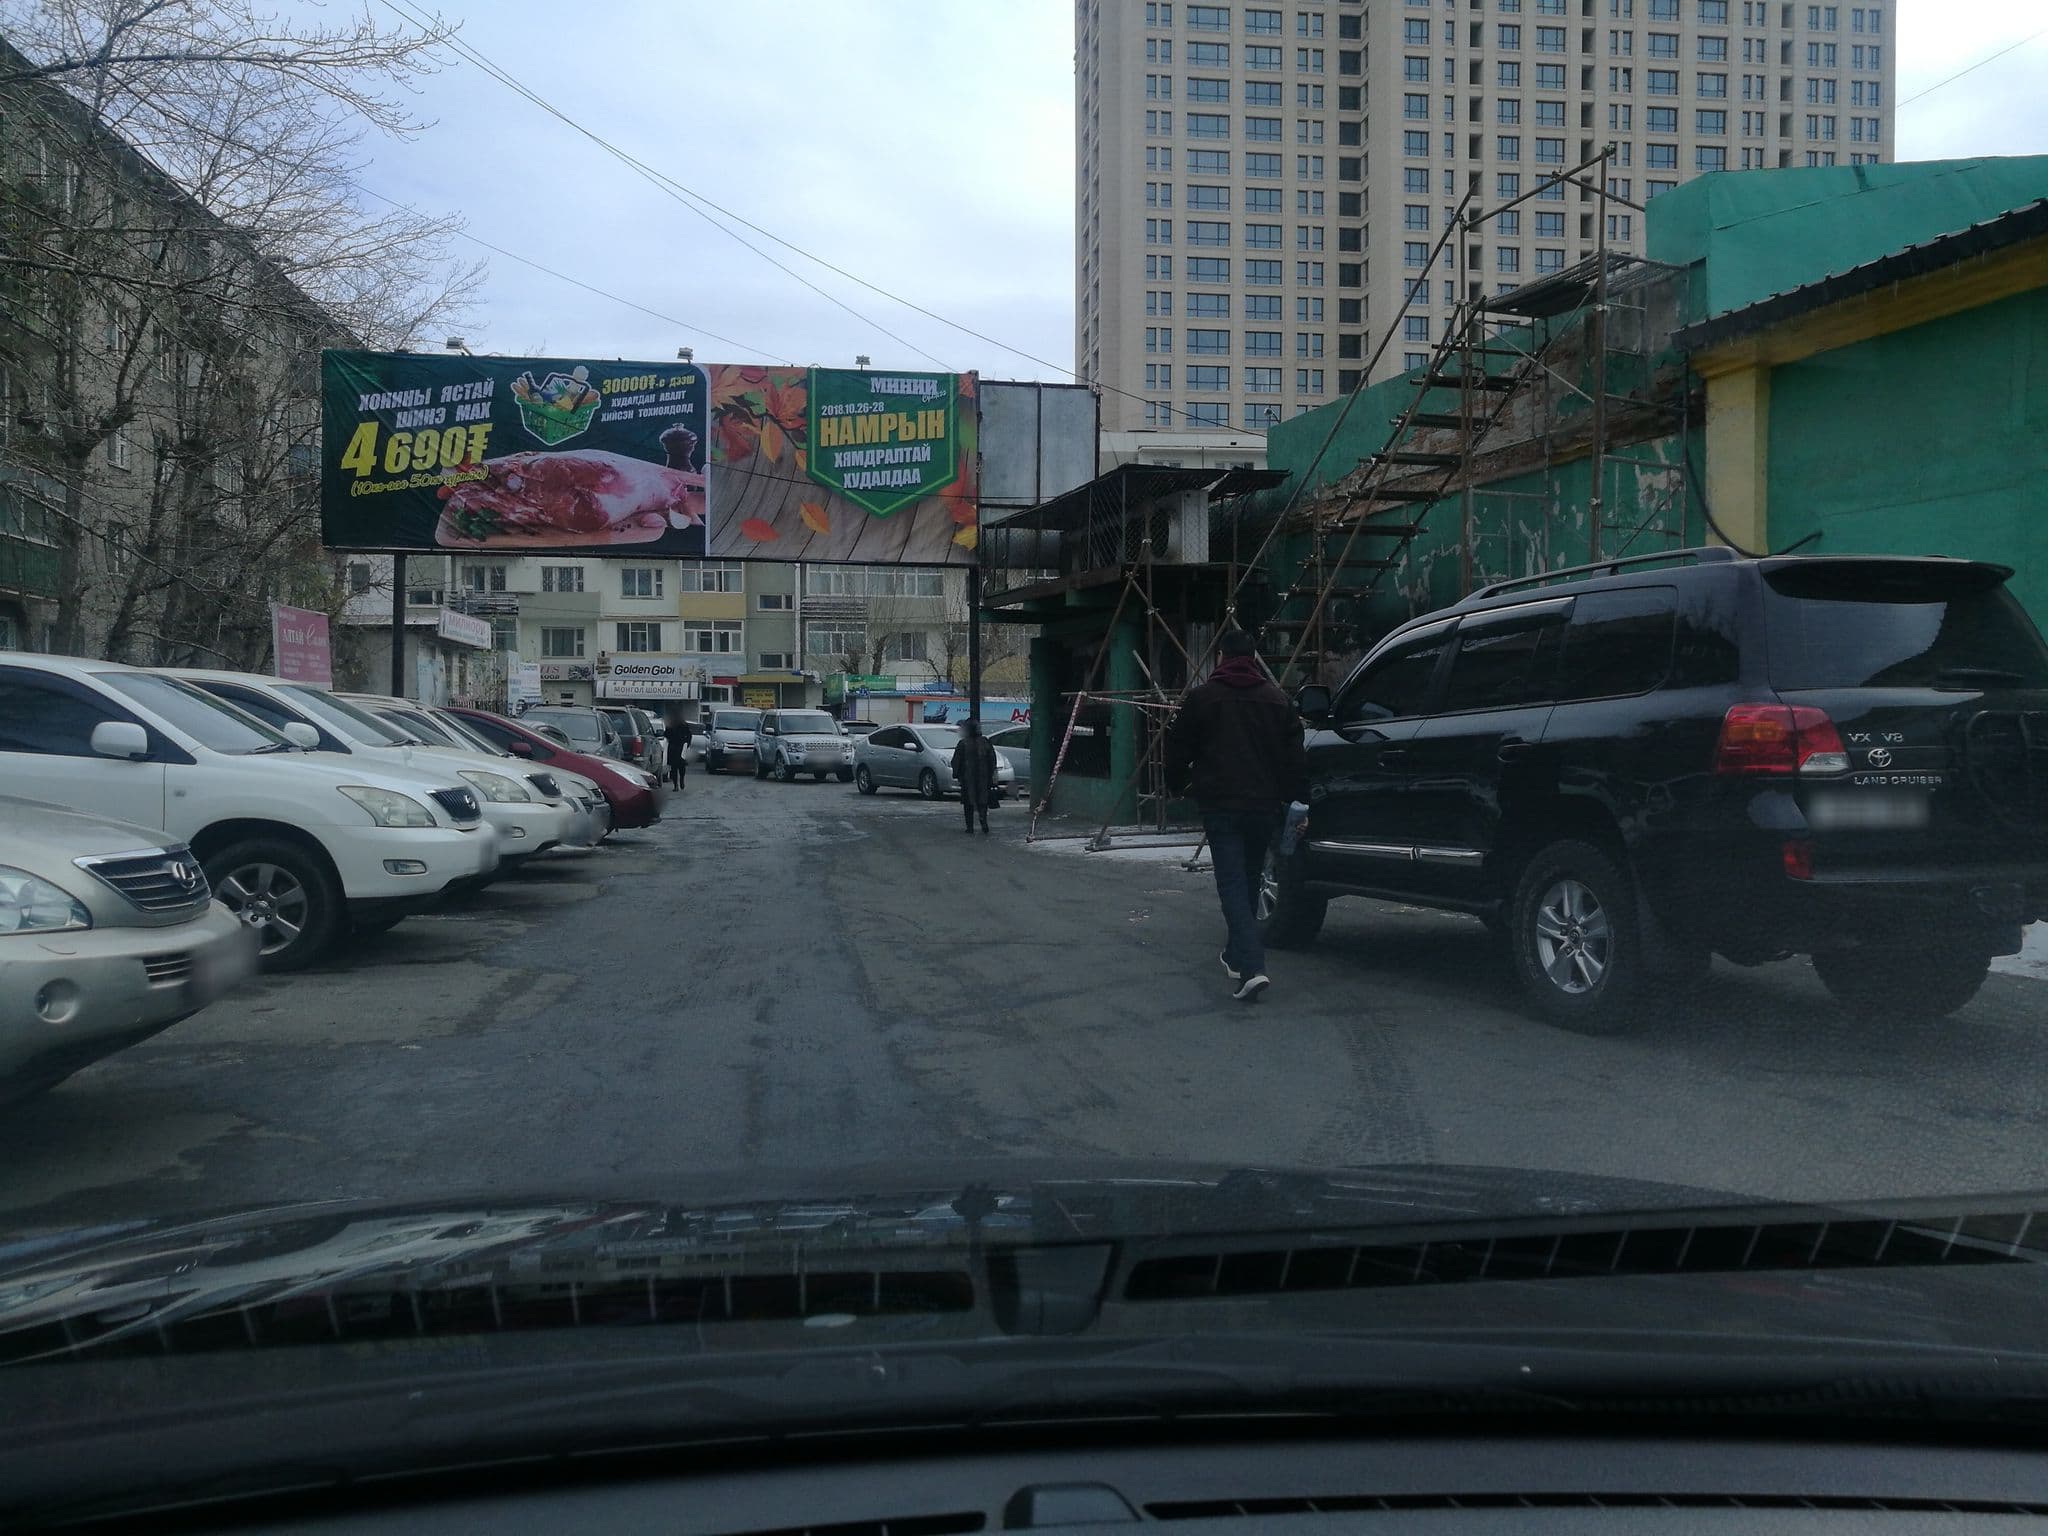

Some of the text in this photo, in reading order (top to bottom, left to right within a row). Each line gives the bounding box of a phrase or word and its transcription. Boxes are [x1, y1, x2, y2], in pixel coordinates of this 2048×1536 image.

[358, 378, 495, 411] ХОНИНЫ ЯСТАЙ
[611, 390, 686, 408] ХУДАЛДАН АВАЛТ
[395, 402, 491, 428] ШИНЭ МАХ
[601, 403, 694, 422] ХИЙСЭН ТОХИОЛДОЛД
[821, 401, 884, 416] 2018.10.26-28
[820, 409, 945, 447] НАМРЫН
[834, 443, 931, 468] ХЯМДРАЛТАЙ
[843, 468, 921, 489] ХУДАЛДАА
[614, 664, 650, 675] Golden
[614, 686, 682, 695] МОНГОЛ ШОКОЛАД
[1847, 733, 1905, 743] VX V8
[1854, 776, 1943, 785] LAND CRUISER
